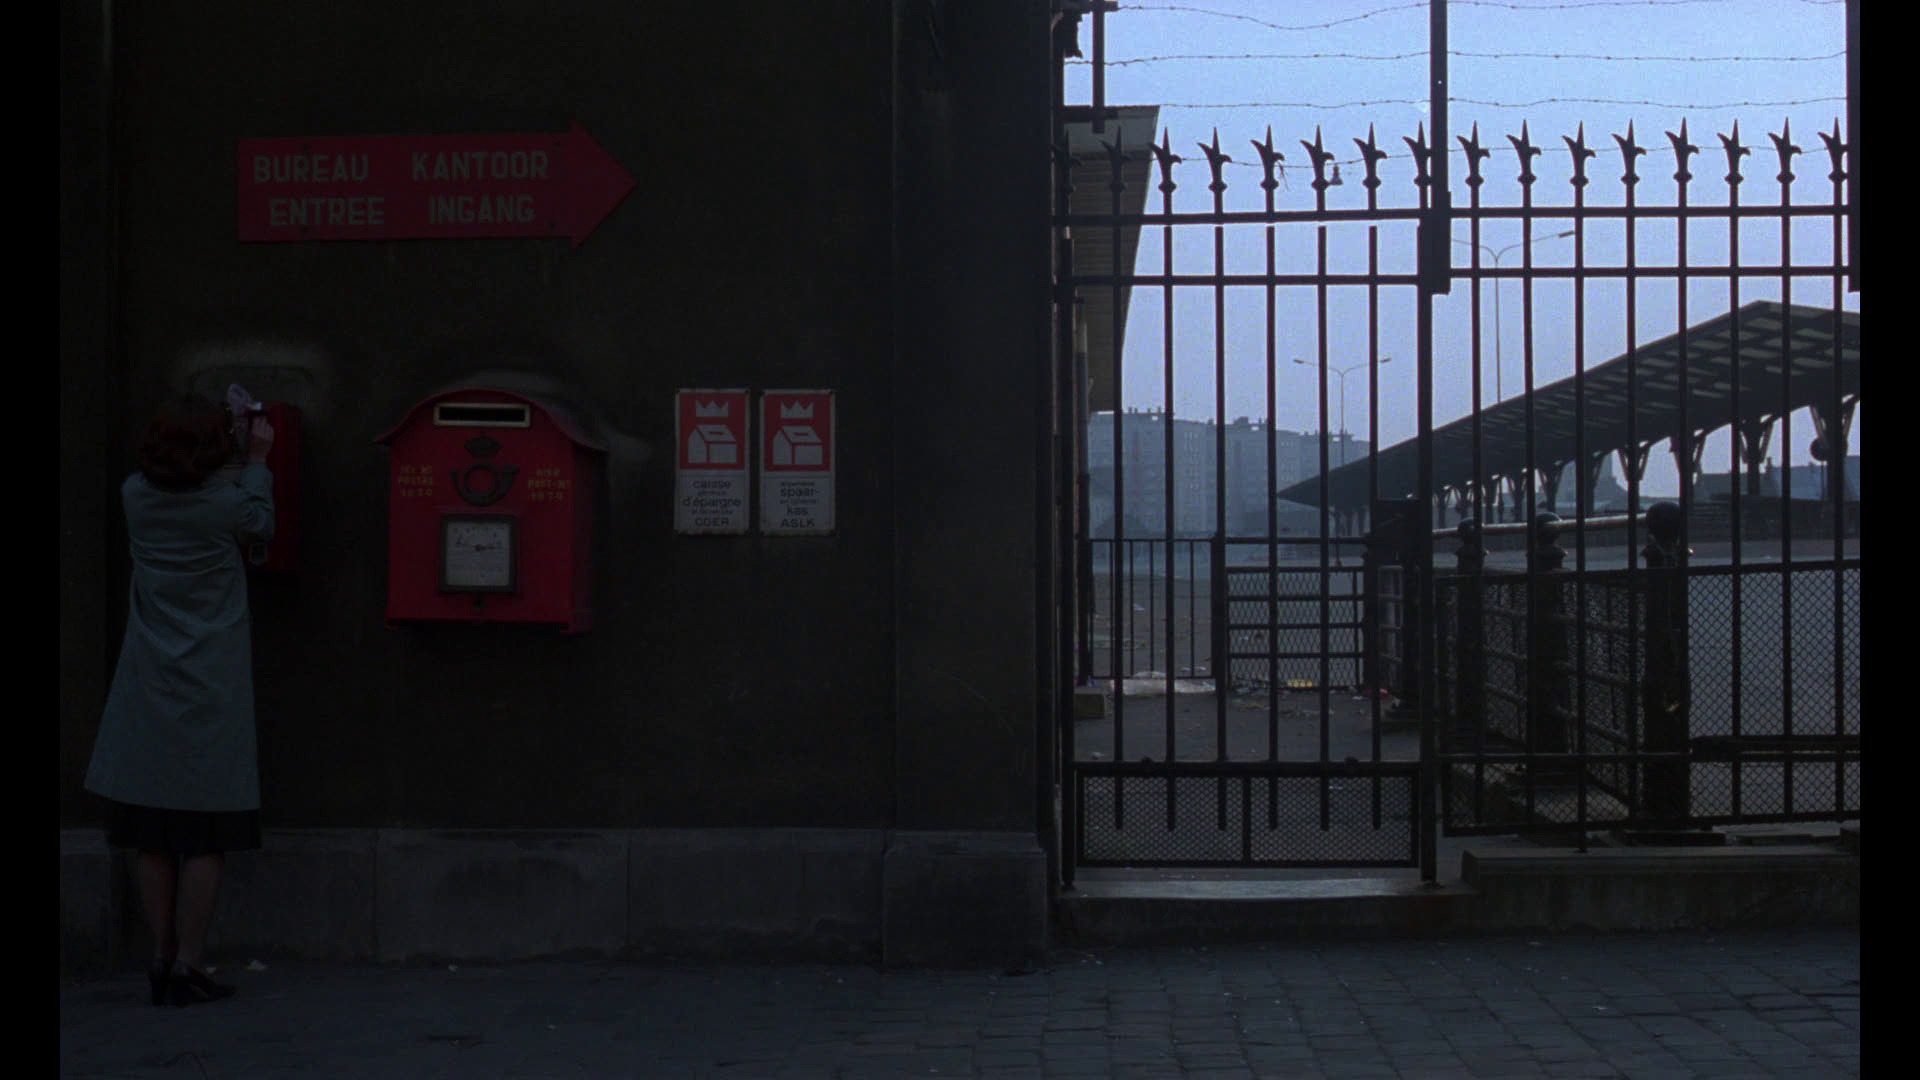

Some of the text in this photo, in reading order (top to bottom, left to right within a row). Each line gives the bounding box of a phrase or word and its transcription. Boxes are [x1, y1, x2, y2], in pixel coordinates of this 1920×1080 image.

[253, 150, 549, 184] BUREAU KANTOOR
[269, 194, 537, 226] ENTREE INGANG
[780, 518, 816, 529] ASLK
